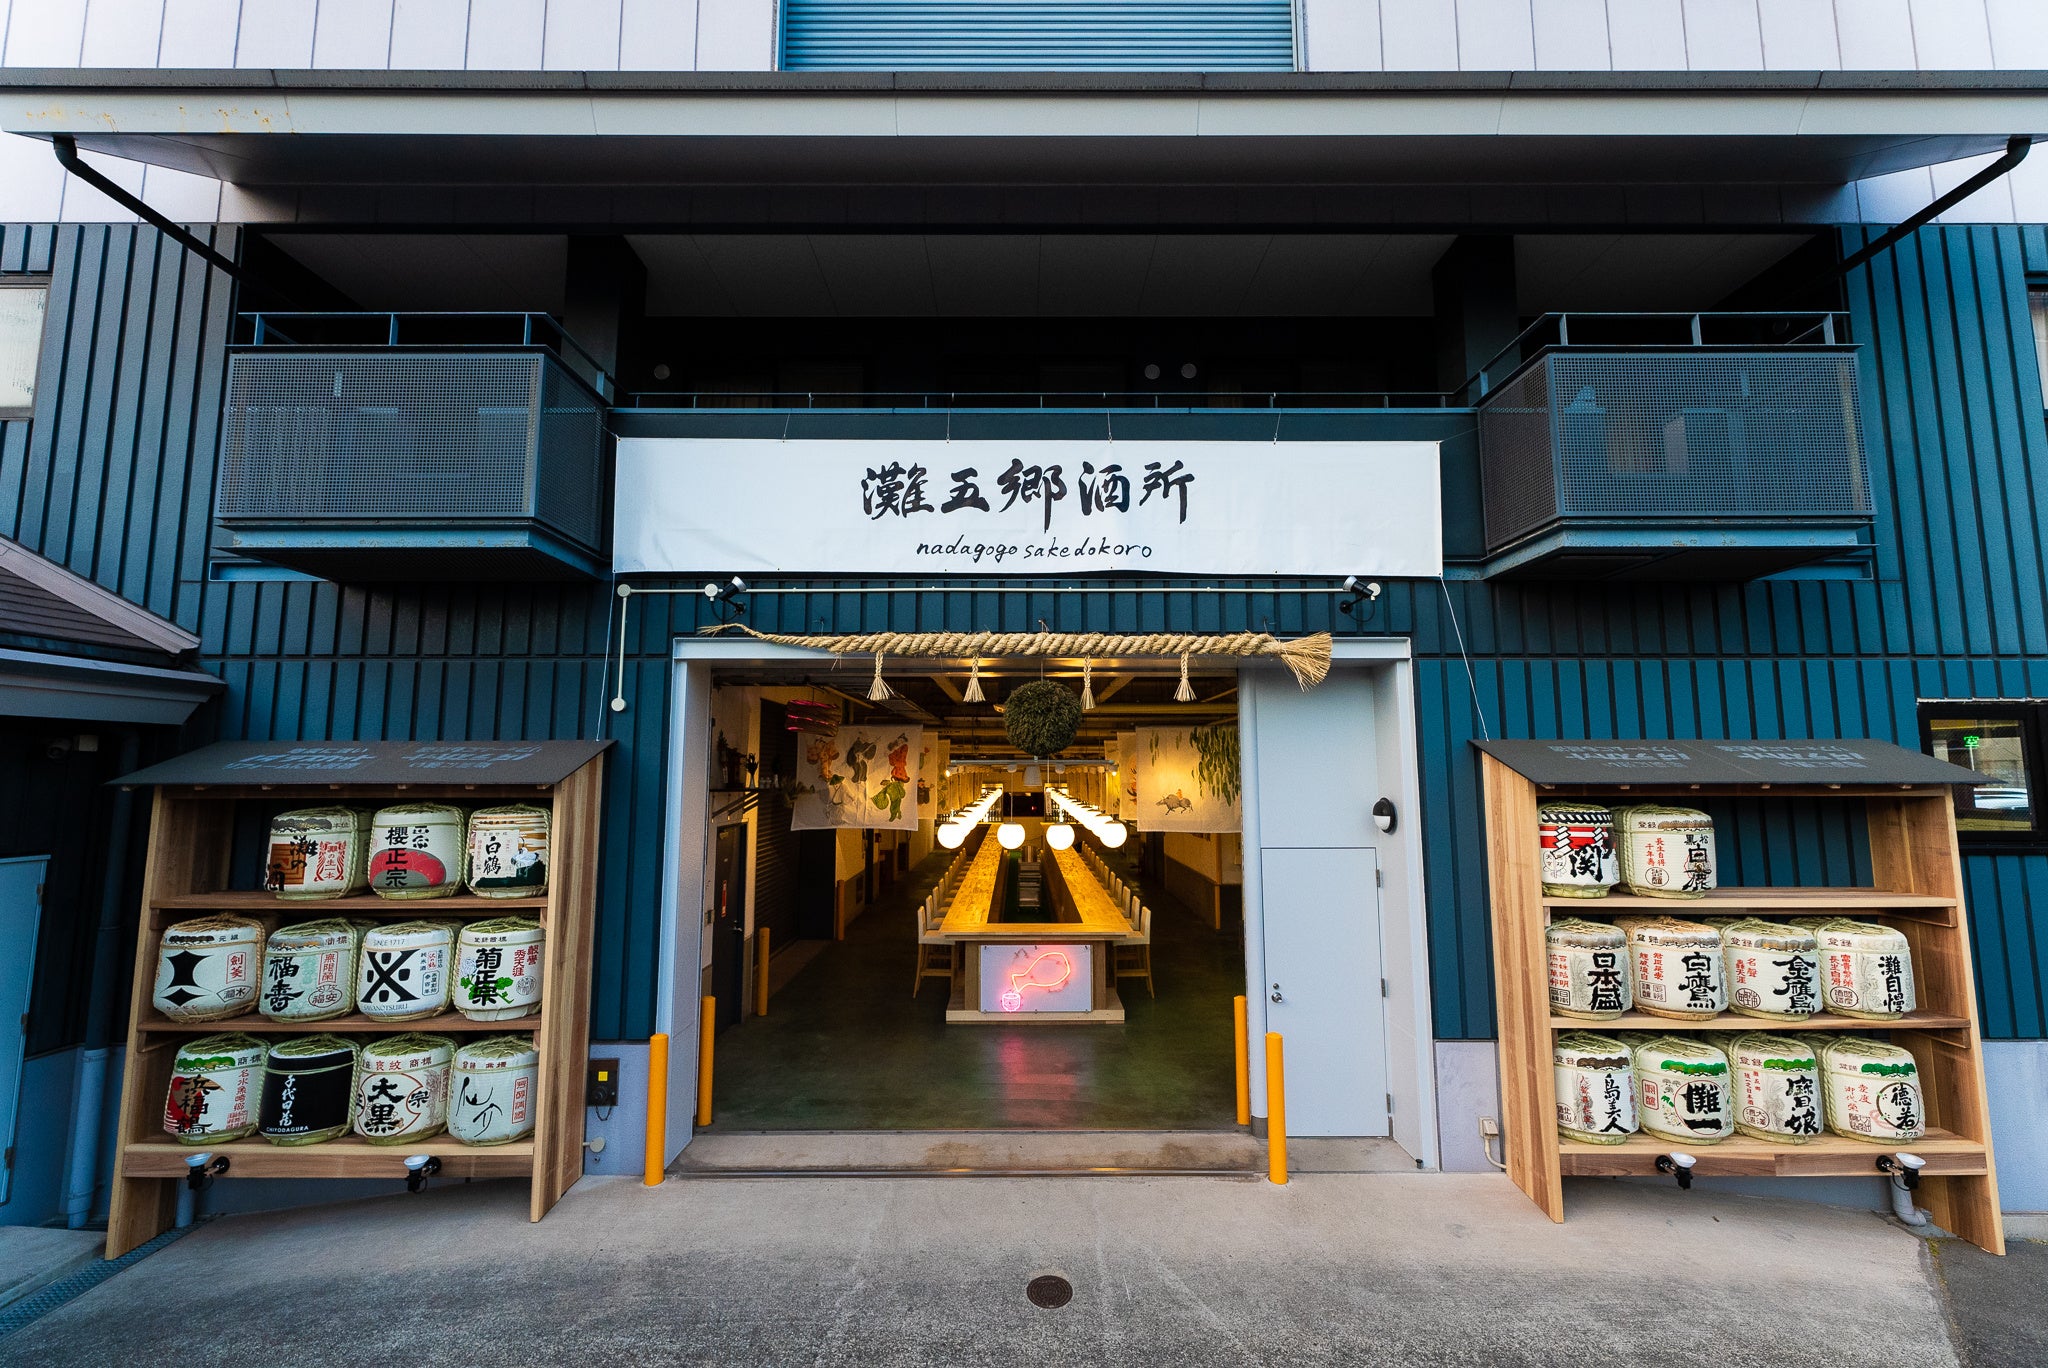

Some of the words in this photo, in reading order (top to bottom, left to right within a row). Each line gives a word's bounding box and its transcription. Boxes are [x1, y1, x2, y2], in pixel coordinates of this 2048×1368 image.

[861, 458, 1195, 534] 灘五郷酒所
[916, 534, 1018, 563] nadagogo
[1023, 537, 1152, 557] sakedokoro
[483, 836, 502, 875] 白鶴
[1588, 952, 1623, 1011] 日本盛
[1878, 954, 1905, 1013] 灘自慢
[265, 1125, 309, 1133] CHIYODAGURA
[364, 1077, 407, 1134] 大黒
